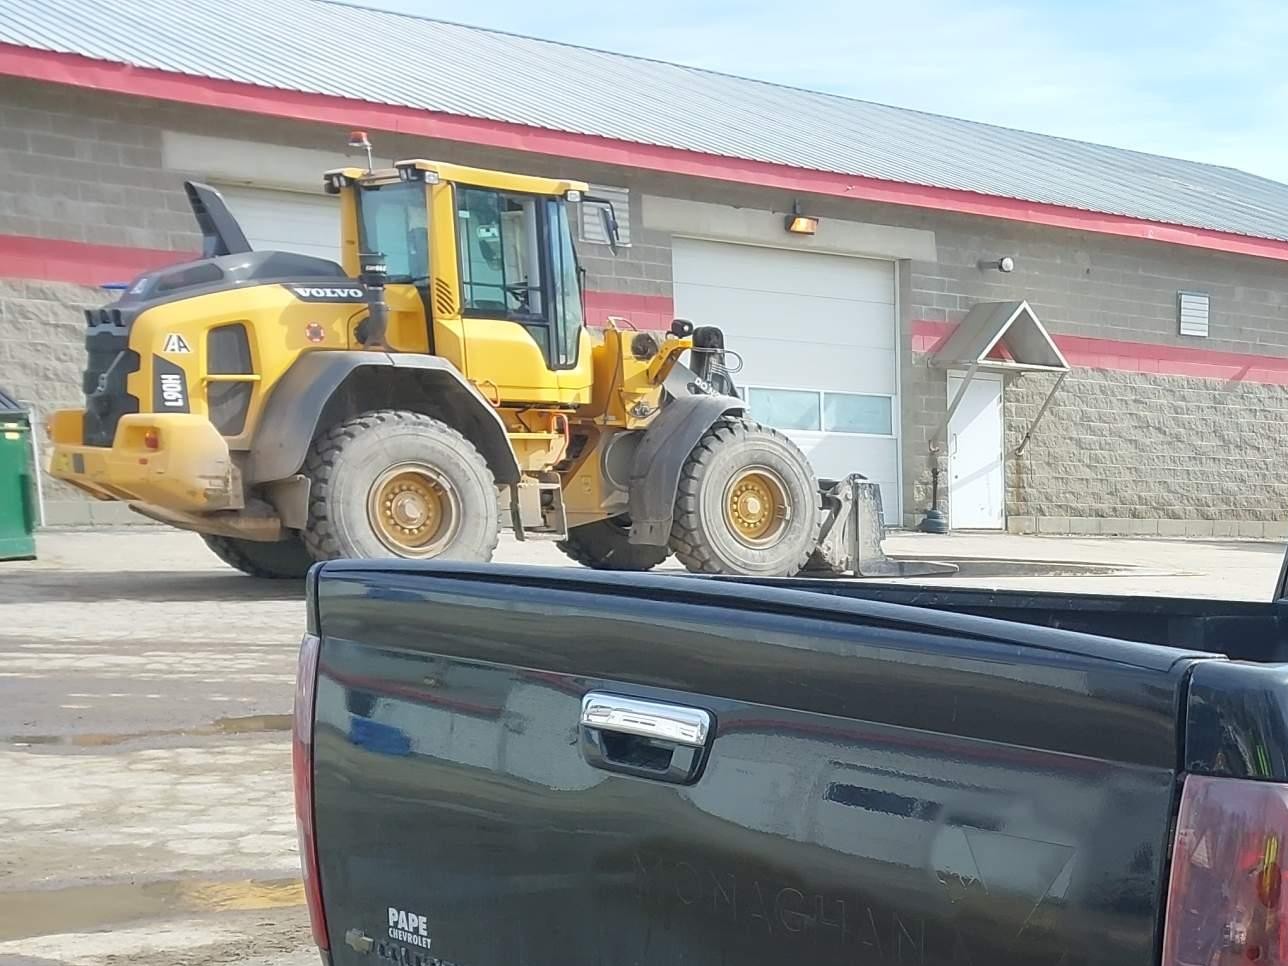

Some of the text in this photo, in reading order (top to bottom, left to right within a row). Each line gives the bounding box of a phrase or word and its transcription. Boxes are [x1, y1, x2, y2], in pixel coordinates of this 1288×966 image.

[293, 287, 363, 298] VOLVO
[160, 374, 184, 407] L90H
[388, 907, 428, 937] PAPE
[388, 927, 433, 950] CHEVROLET
